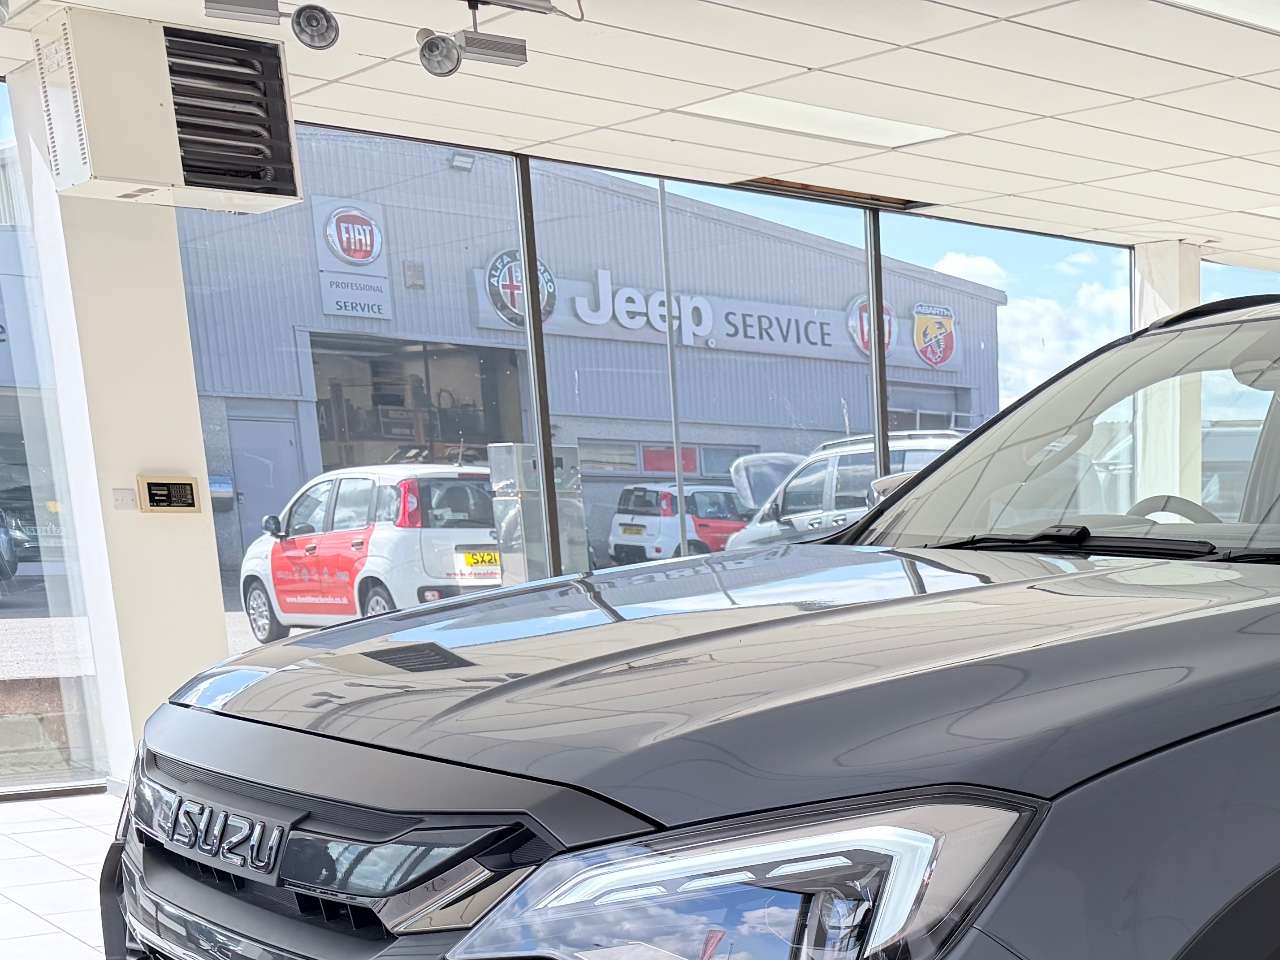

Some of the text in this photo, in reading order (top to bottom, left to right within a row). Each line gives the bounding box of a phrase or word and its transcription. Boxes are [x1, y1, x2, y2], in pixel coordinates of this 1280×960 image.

[340, 222, 372, 251] FIAT
[490, 255, 512, 287] ALFA
[329, 281, 384, 294] PROFESSIONAL
[335, 300, 385, 314] SERVICE
[574, 268, 712, 346] Jeep
[725, 311, 833, 347] SERVICE
[167, 796, 284, 874] ISUZU
